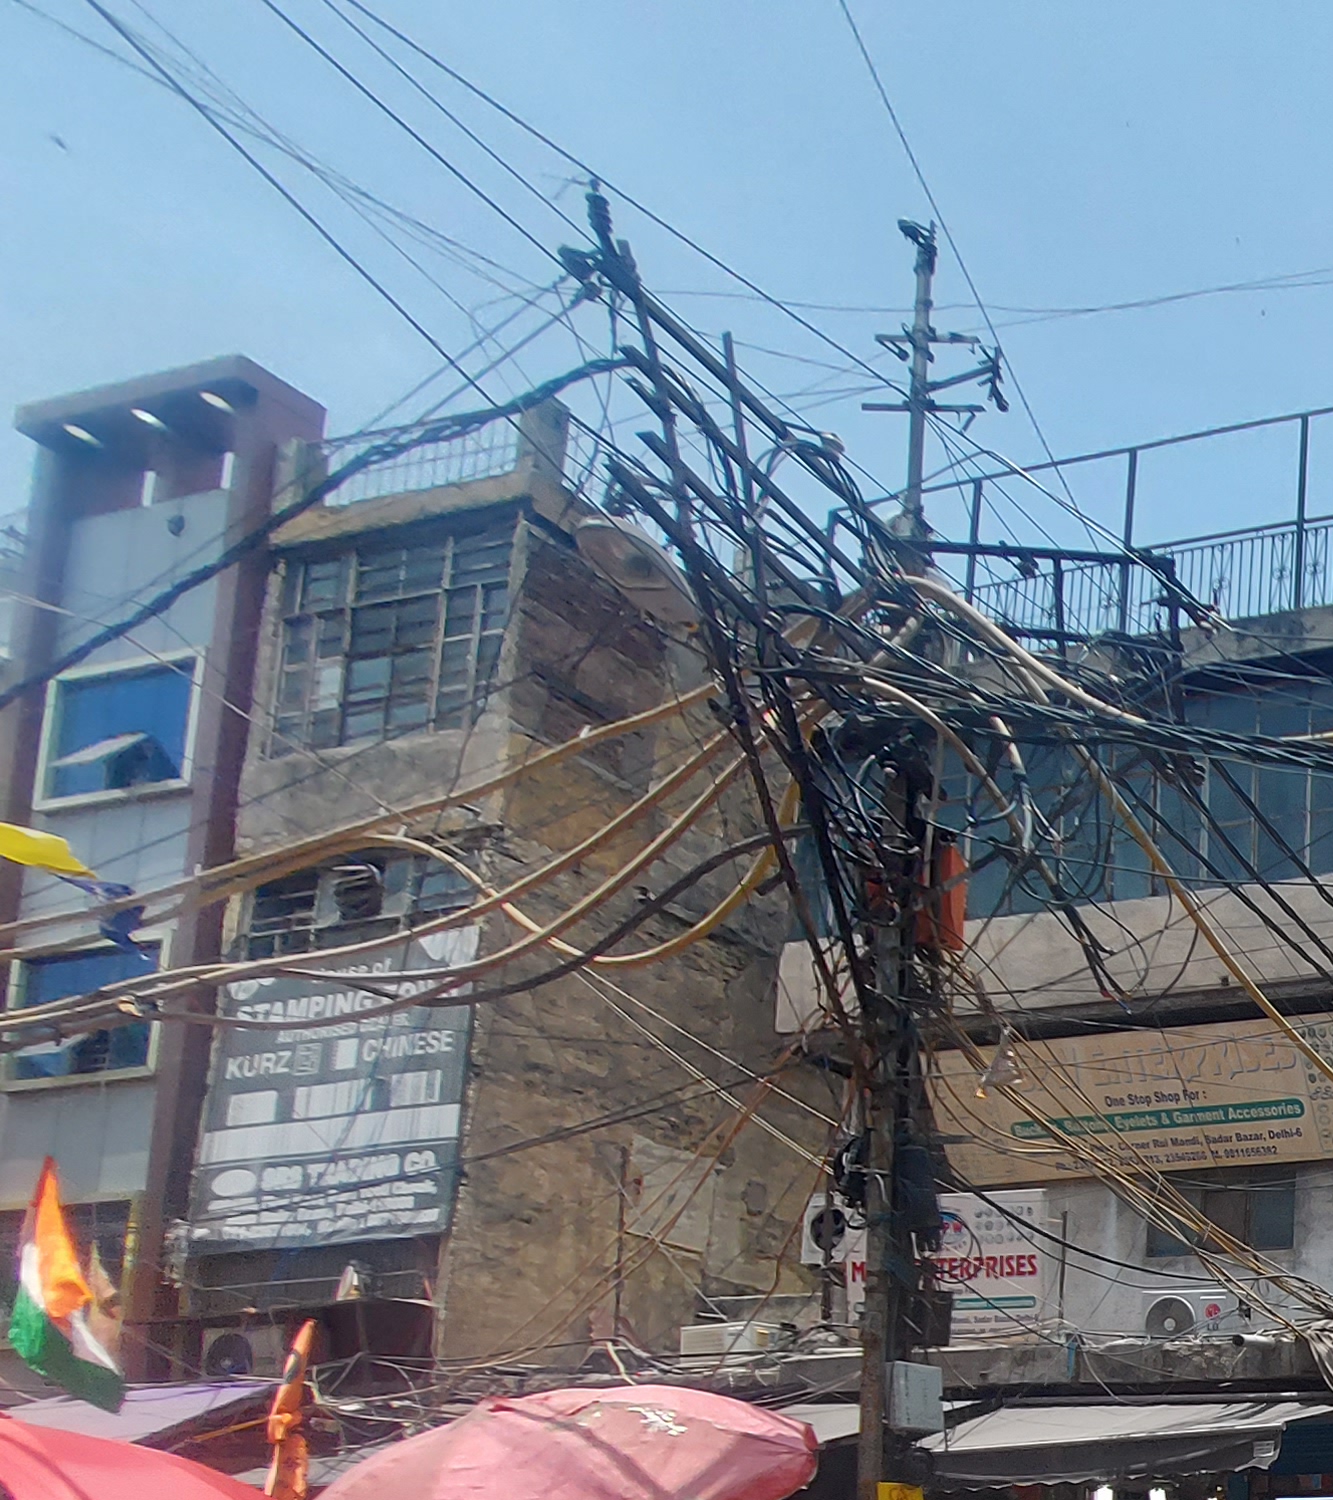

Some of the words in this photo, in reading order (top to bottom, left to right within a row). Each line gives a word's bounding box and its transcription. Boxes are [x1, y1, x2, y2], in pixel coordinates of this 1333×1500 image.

[225, 1050, 293, 1080] KURZ
[361, 1029, 456, 1063] CHINESE
[1104, 1093, 1127, 1107] One
[1128, 1092, 1152, 1108] Stop
[1153, 1089, 1181, 1106] Shop
[1173, 1106, 1225, 1124] Garment
[1228, 1103, 1302, 1121] Accessories
[1268, 1127, 1303, 1140] Delhi-6
